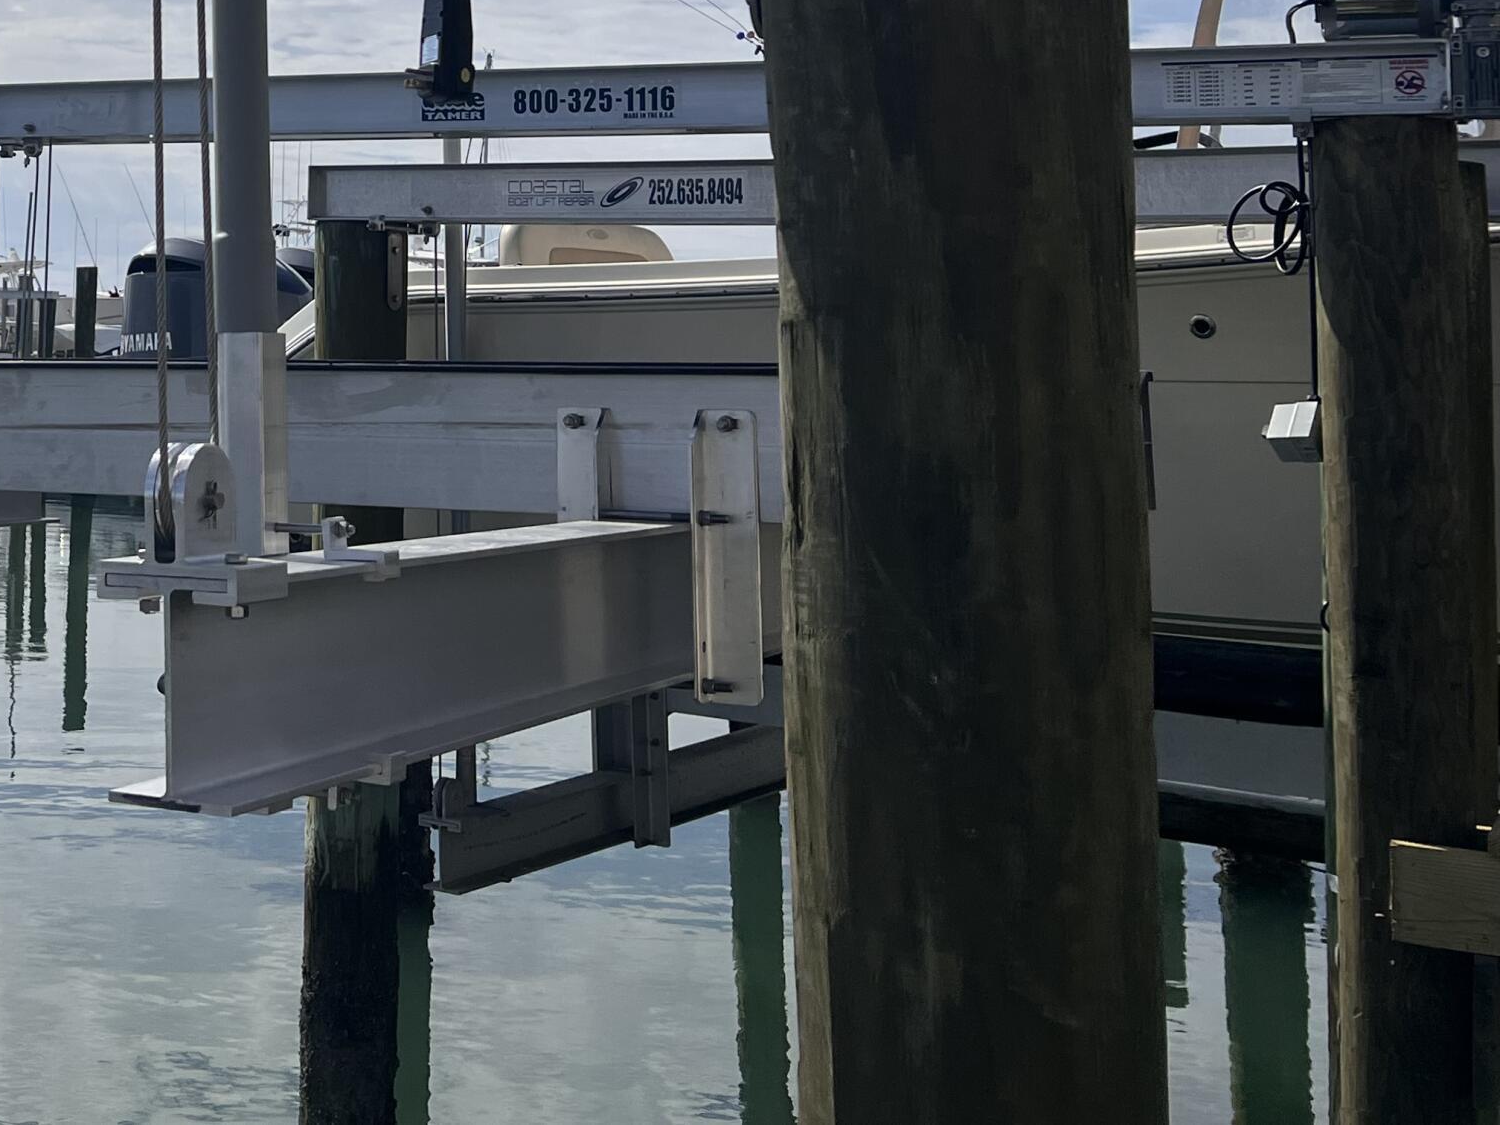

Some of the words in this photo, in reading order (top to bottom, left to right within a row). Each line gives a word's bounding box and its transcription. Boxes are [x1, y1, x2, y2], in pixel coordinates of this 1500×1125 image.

[513, 85, 676, 114] 800-325-1116
[424, 111, 482, 120] TAMER
[648, 177, 744, 206] 252.635.8494
